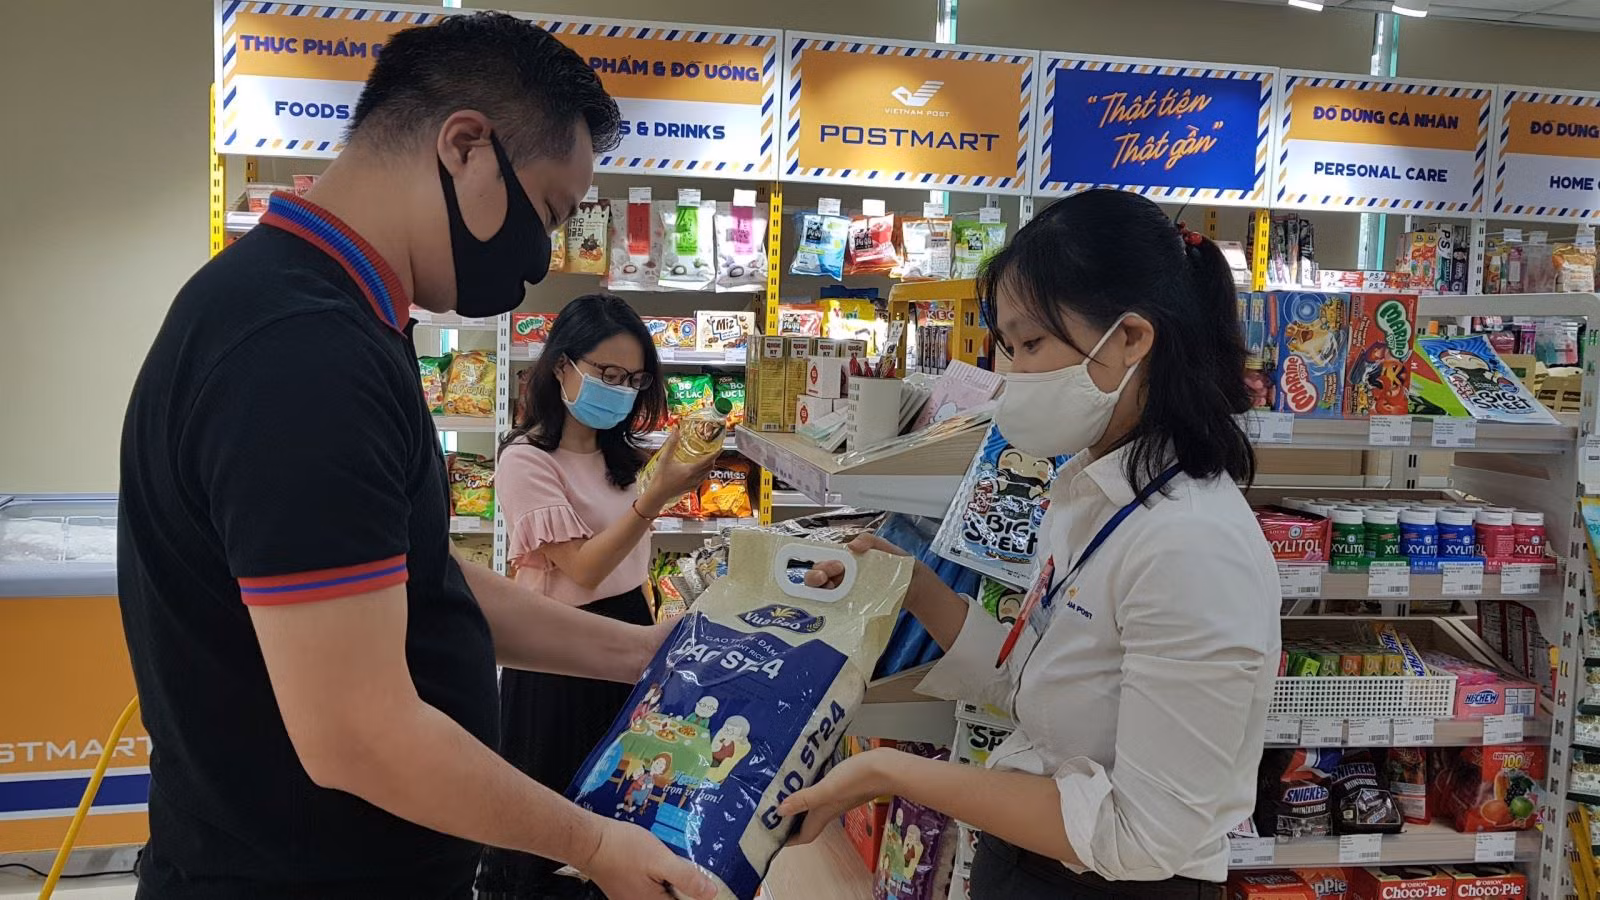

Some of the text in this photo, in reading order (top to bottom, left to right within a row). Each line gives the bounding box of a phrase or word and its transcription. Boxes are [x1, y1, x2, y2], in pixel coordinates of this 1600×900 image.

[653, 61, 665, 76] &
[274, 101, 350, 120] FOODS
[884, 107, 950, 118] VIETNAM POST
[636, 121, 649, 136] &
[654, 122, 726, 140] DRINKS
[820, 124, 1000, 152] POSTMART
[1313, 160, 1449, 183] PERSONAL CARE
[1549, 174, 1594, 191] HOME
[986, 514, 1030, 536] BIG
[1267, 539, 1322, 553] XYLITOL
[1076, 606, 1093, 621] POST
[800, 700, 846, 770] ST24
